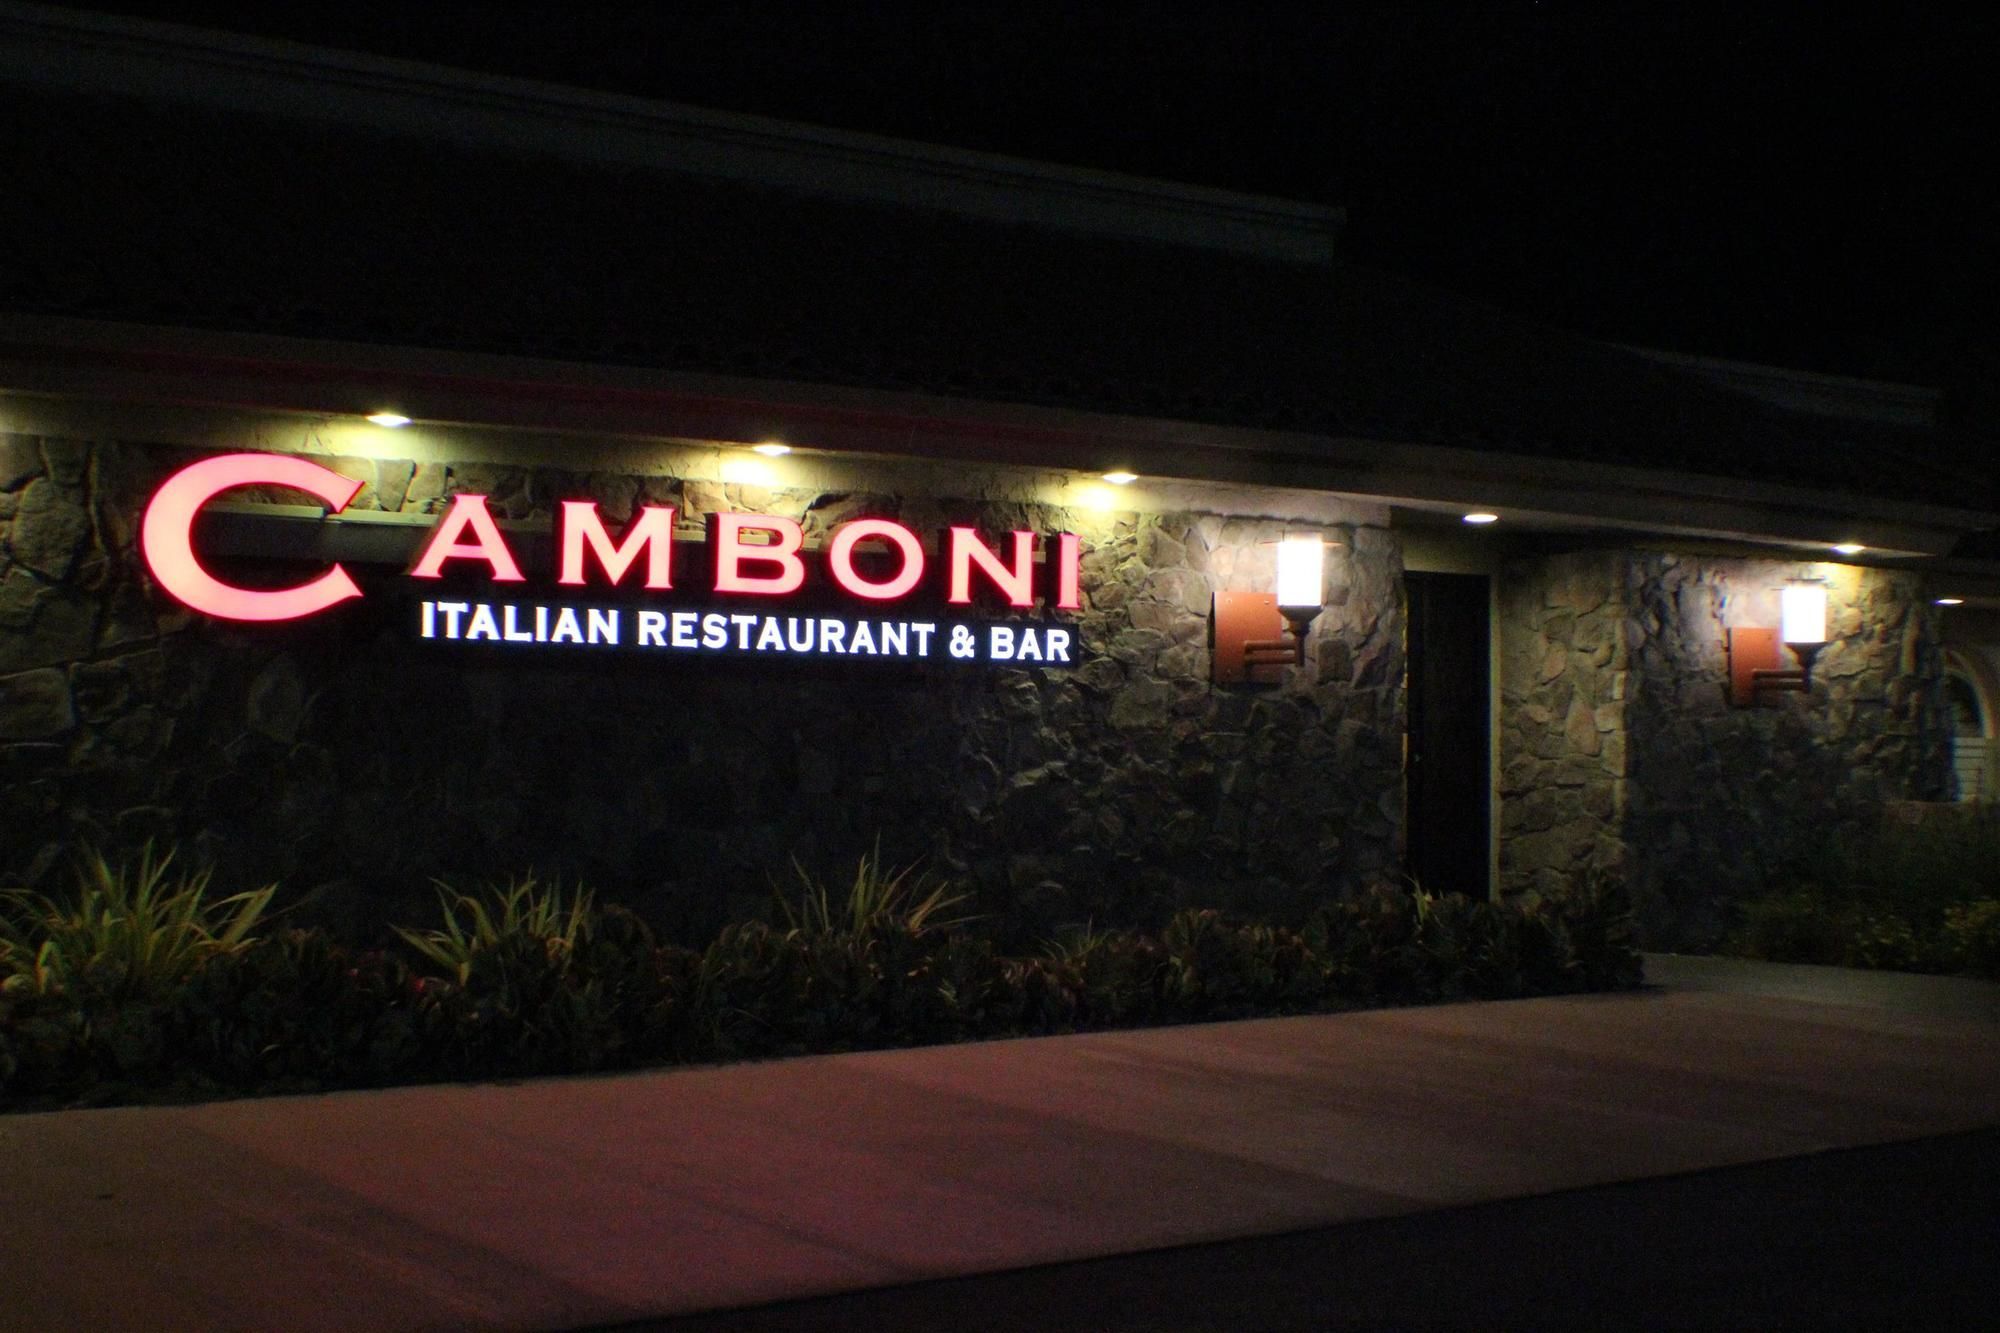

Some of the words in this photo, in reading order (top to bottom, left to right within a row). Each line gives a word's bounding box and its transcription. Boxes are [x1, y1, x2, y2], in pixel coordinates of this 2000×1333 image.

[142, 453, 1083, 622] CAMBONI
[421, 601, 619, 645] ITALIAN
[637, 610, 935, 656] RESTAURANT
[949, 624, 976, 659] &
[990, 626, 1071, 662] BAR
